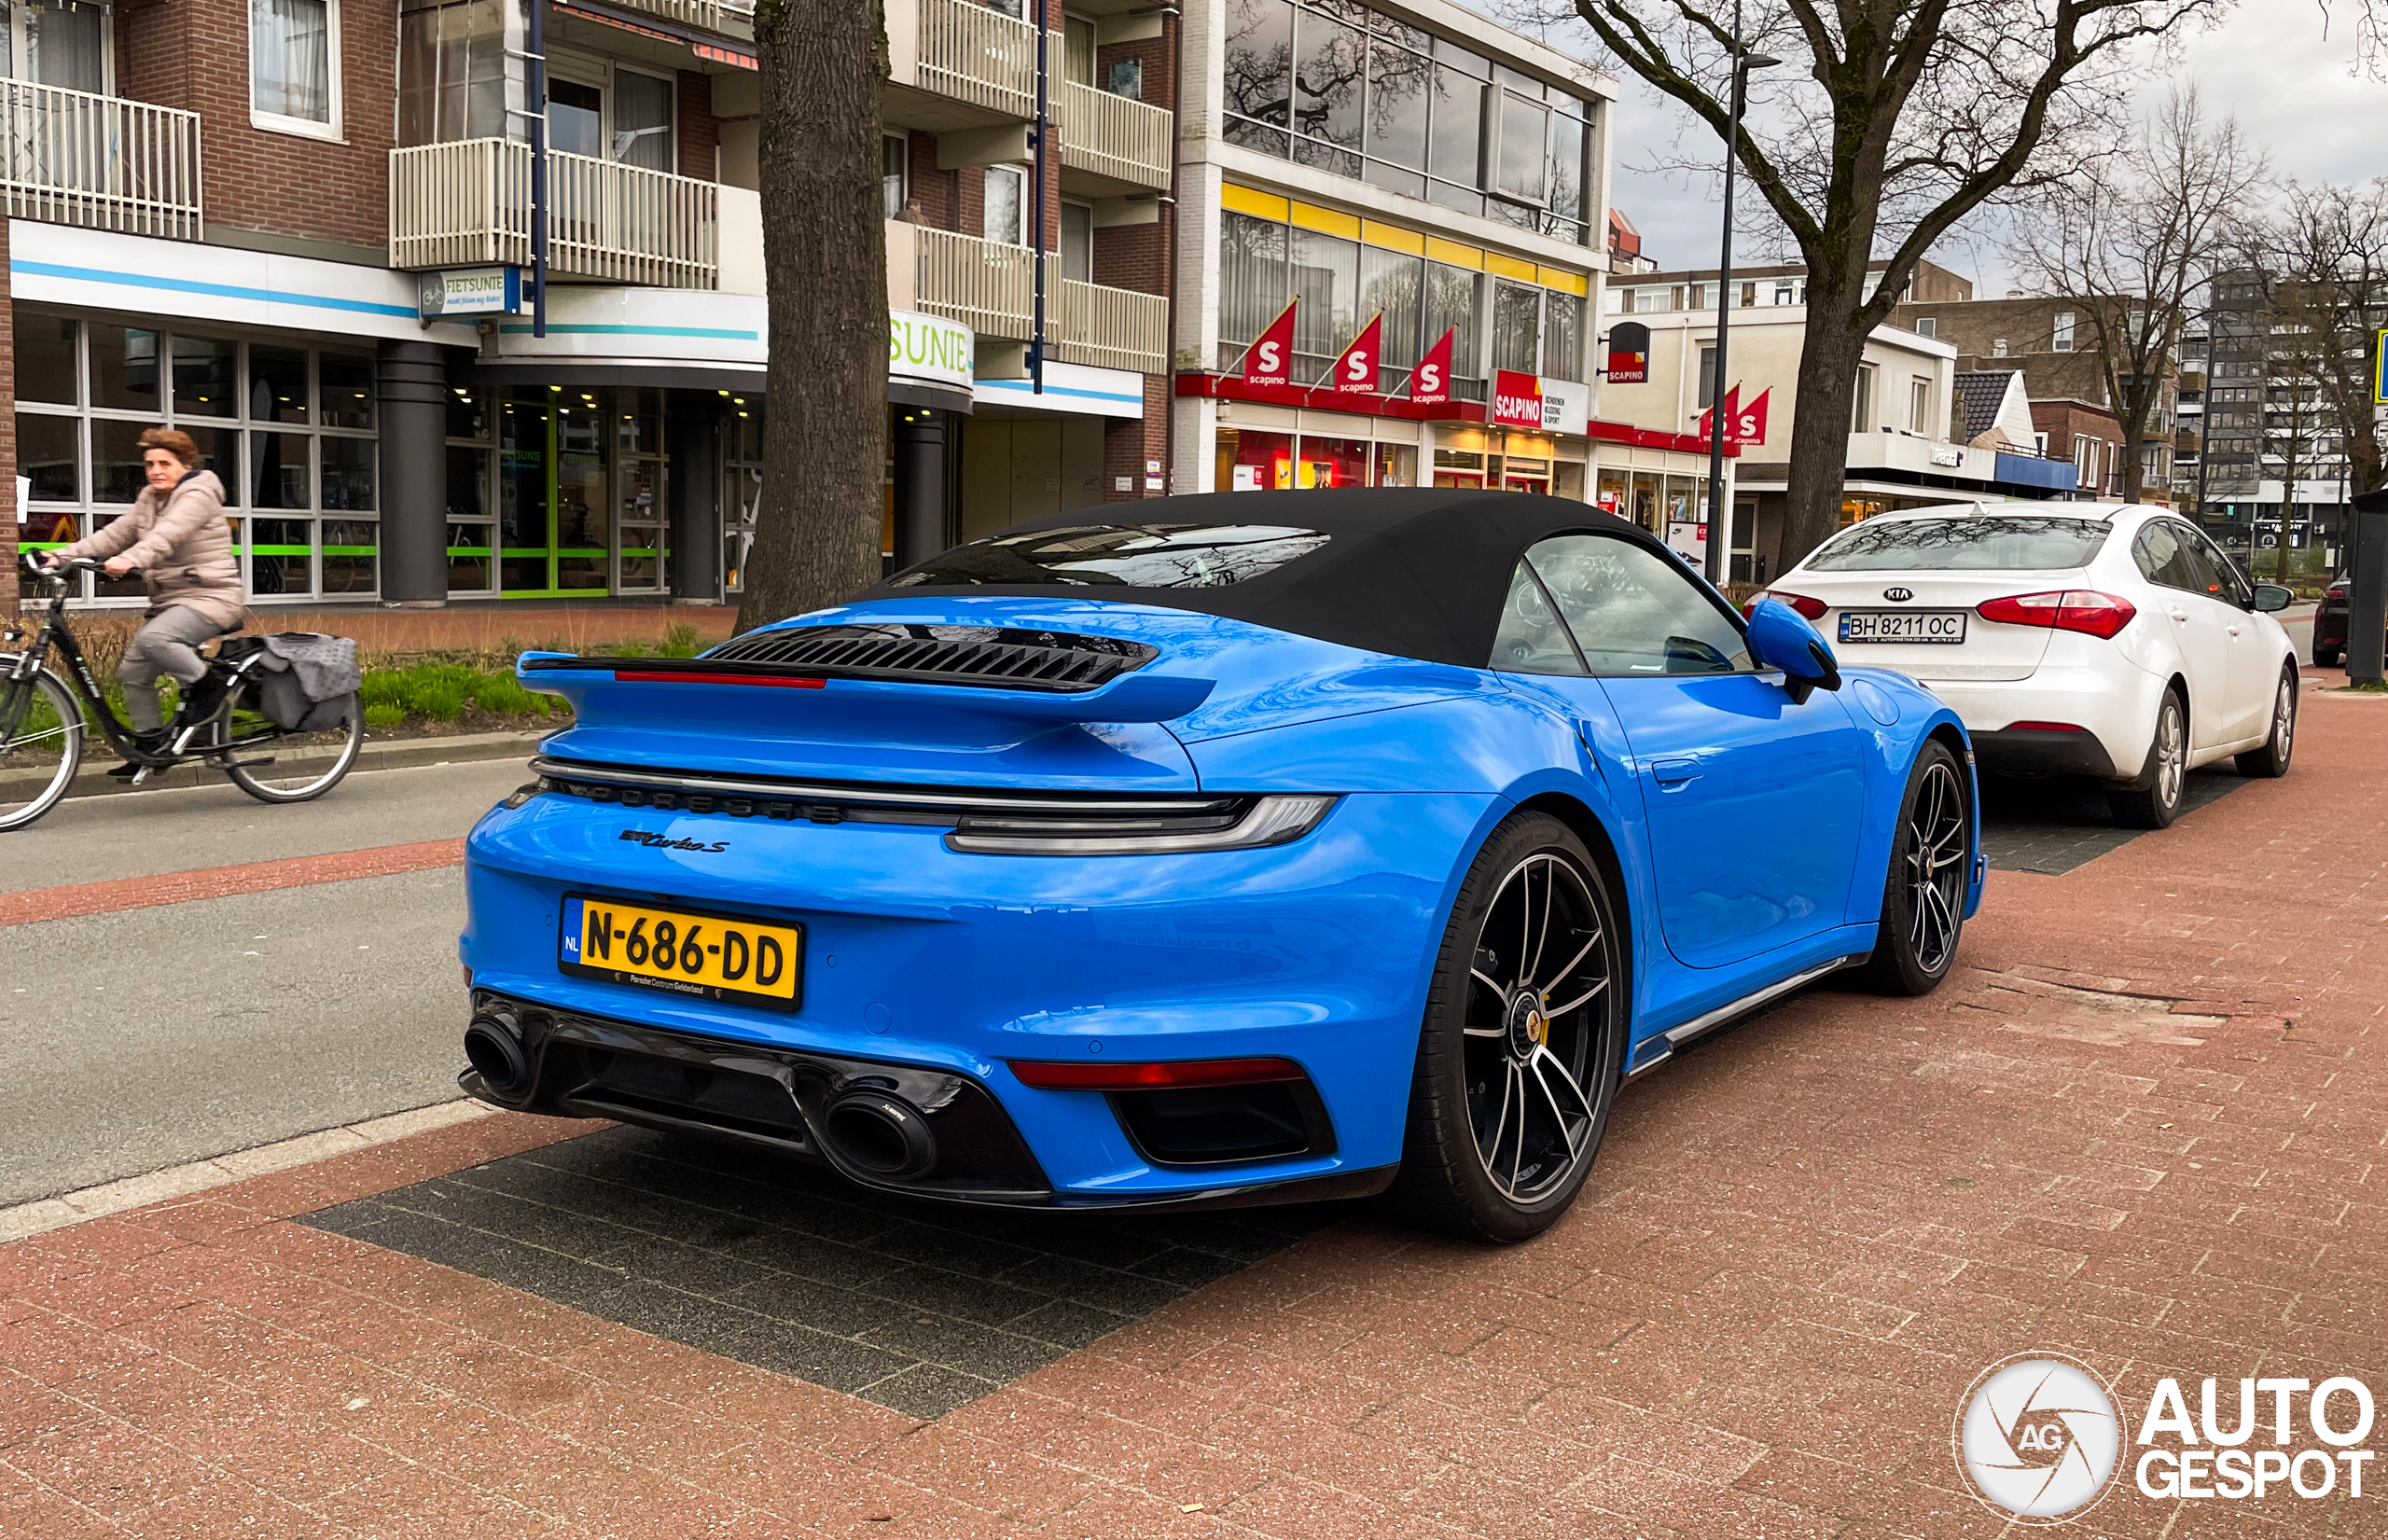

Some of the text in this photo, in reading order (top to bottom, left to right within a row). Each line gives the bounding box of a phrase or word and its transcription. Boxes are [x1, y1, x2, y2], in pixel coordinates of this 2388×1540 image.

[446, 276, 503, 293] FIETSUNIE
[1258, 341, 1280, 372] S
[1347, 352, 1368, 381] S
[1250, 375, 1285, 386] scapino
[1421, 364, 1440, 393] S
[1609, 371, 1644, 381] SCAPINO
[1340, 383, 1374, 393] scapino
[1413, 394, 1446, 404] scapino
[1545, 395, 1564, 407] SCHOENEN
[1495, 395, 1539, 422] SCAPINO
[1739, 415, 1756, 437] S
[1887, 590, 1909, 599] KIA
[1851, 617, 1957, 635] BH 8211 OC
[701, 841, 730, 853] S
[565, 936, 578, 952] NL
[587, 909, 784, 986] N-686-DD
[631, 975, 703, 994] Porsche Centrum Gelderland
